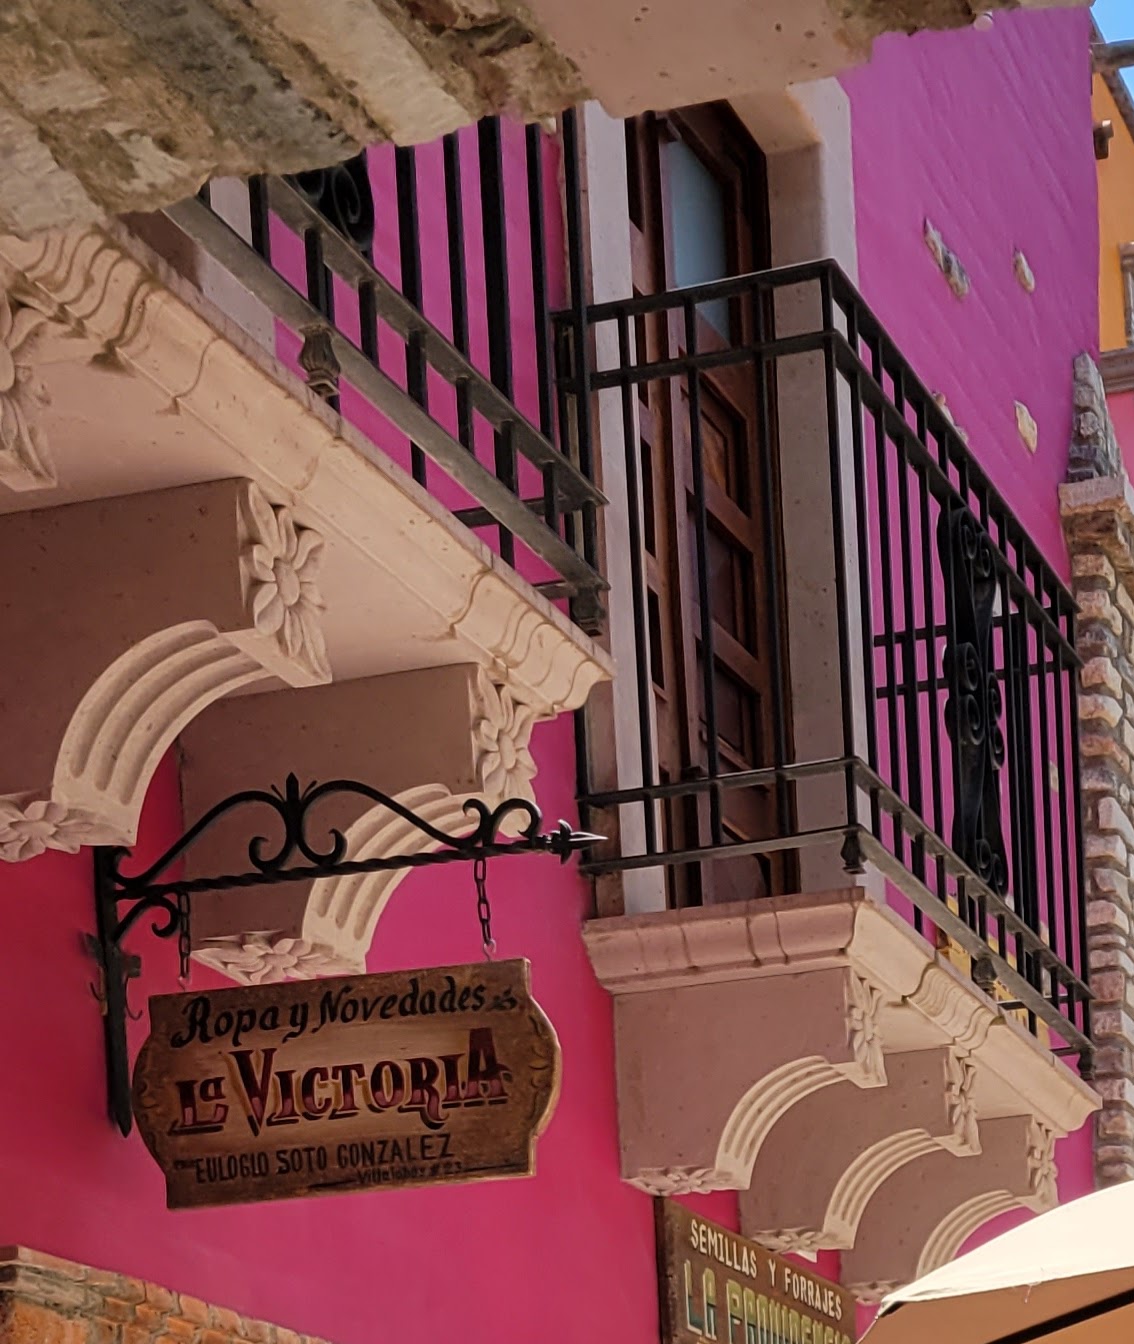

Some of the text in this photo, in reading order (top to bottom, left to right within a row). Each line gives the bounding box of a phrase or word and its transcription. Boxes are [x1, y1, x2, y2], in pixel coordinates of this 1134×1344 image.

[170, 976, 488, 1048] Ropa y Novedades
[229, 1027, 511, 1135] VICTORIA
[195, 1133, 456, 1184] EULOGIO SOTO GONZALEZ
[684, 1258, 718, 1341] LA
[690, 1218, 843, 1321] SEMILLAS Y FORRAJES
